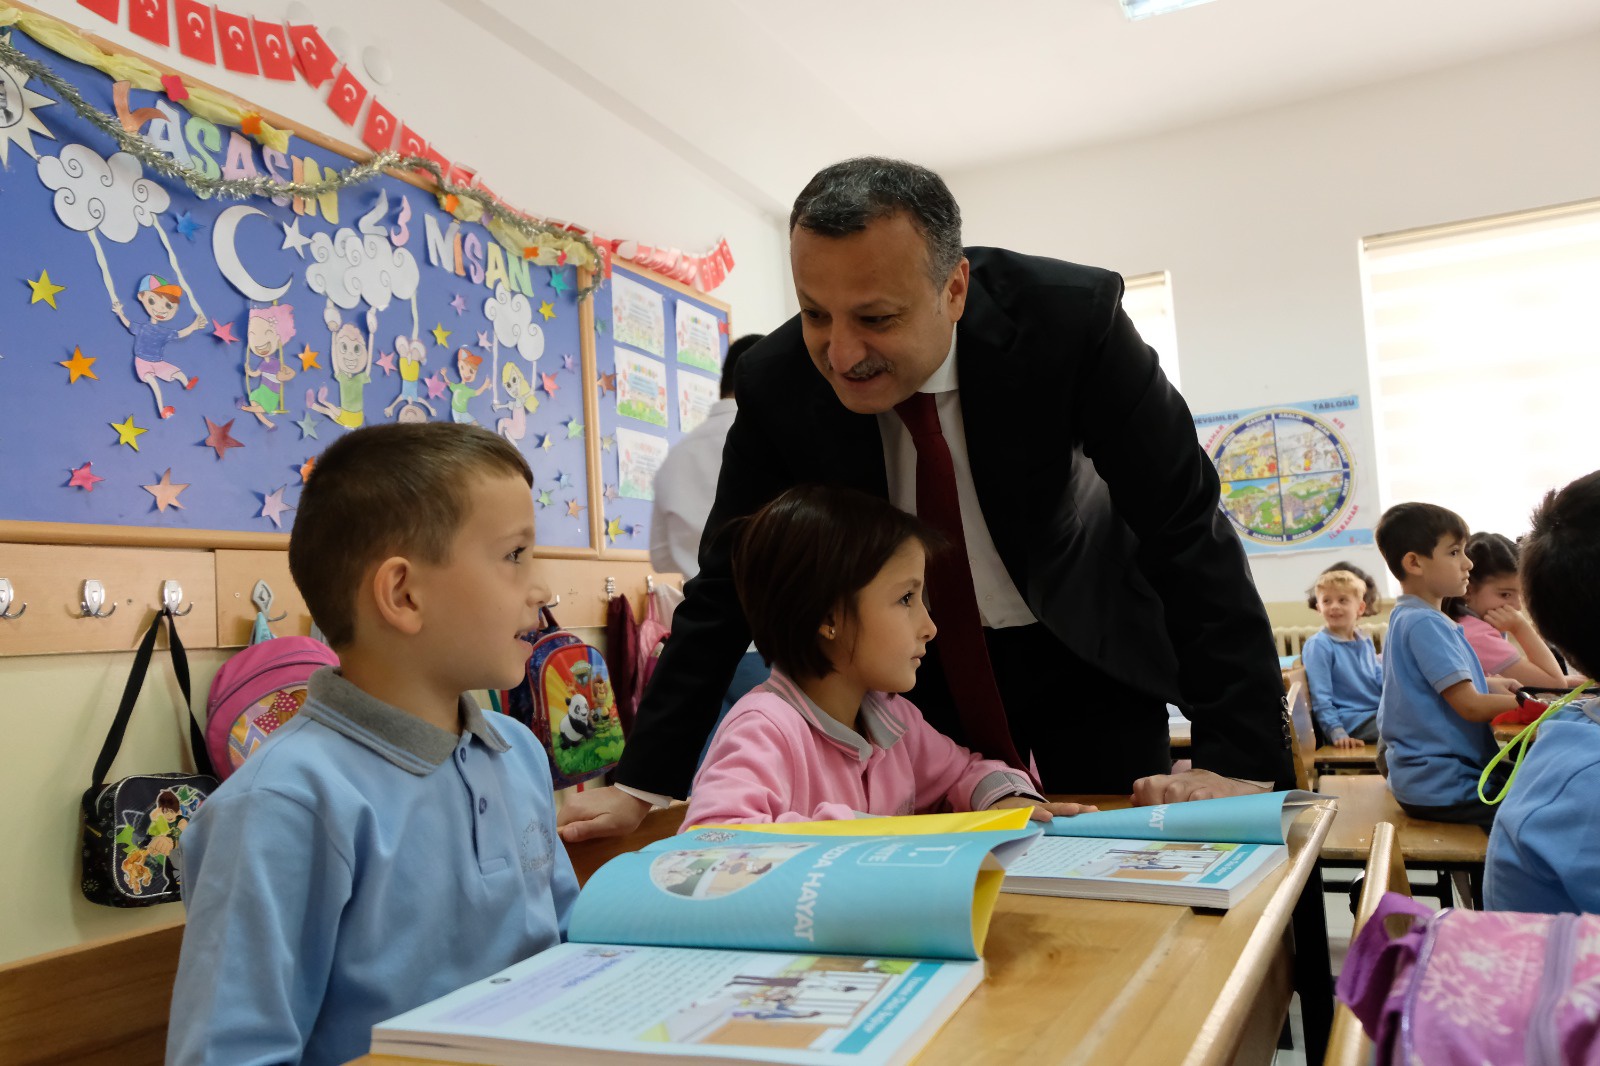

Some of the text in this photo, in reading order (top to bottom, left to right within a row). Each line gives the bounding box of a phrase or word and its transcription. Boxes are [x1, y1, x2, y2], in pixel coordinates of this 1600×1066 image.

[358, 187, 411, 247] 23
[1313, 399, 1355, 410] TABLOSU
[794, 872, 825, 942] HAYAT
